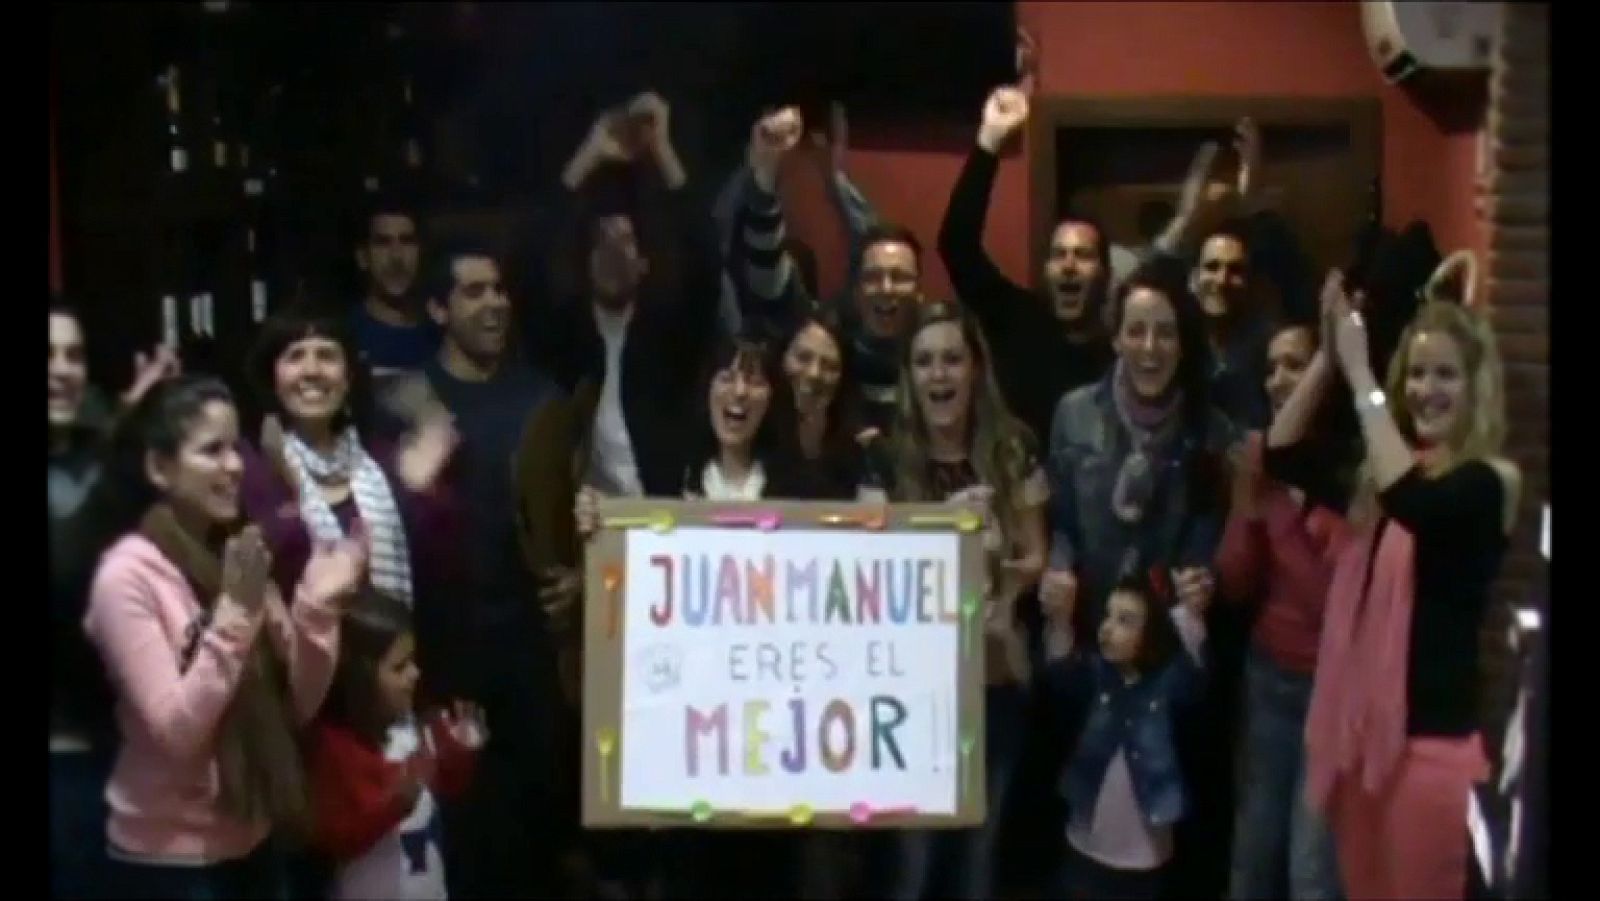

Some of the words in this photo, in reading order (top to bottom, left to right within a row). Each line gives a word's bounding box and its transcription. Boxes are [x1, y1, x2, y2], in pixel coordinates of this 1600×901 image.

[649, 554, 776, 627] JUAN
[784, 558, 958, 625] MANUEL
[728, 641, 838, 682] ERES
[866, 640, 905, 677] EL
